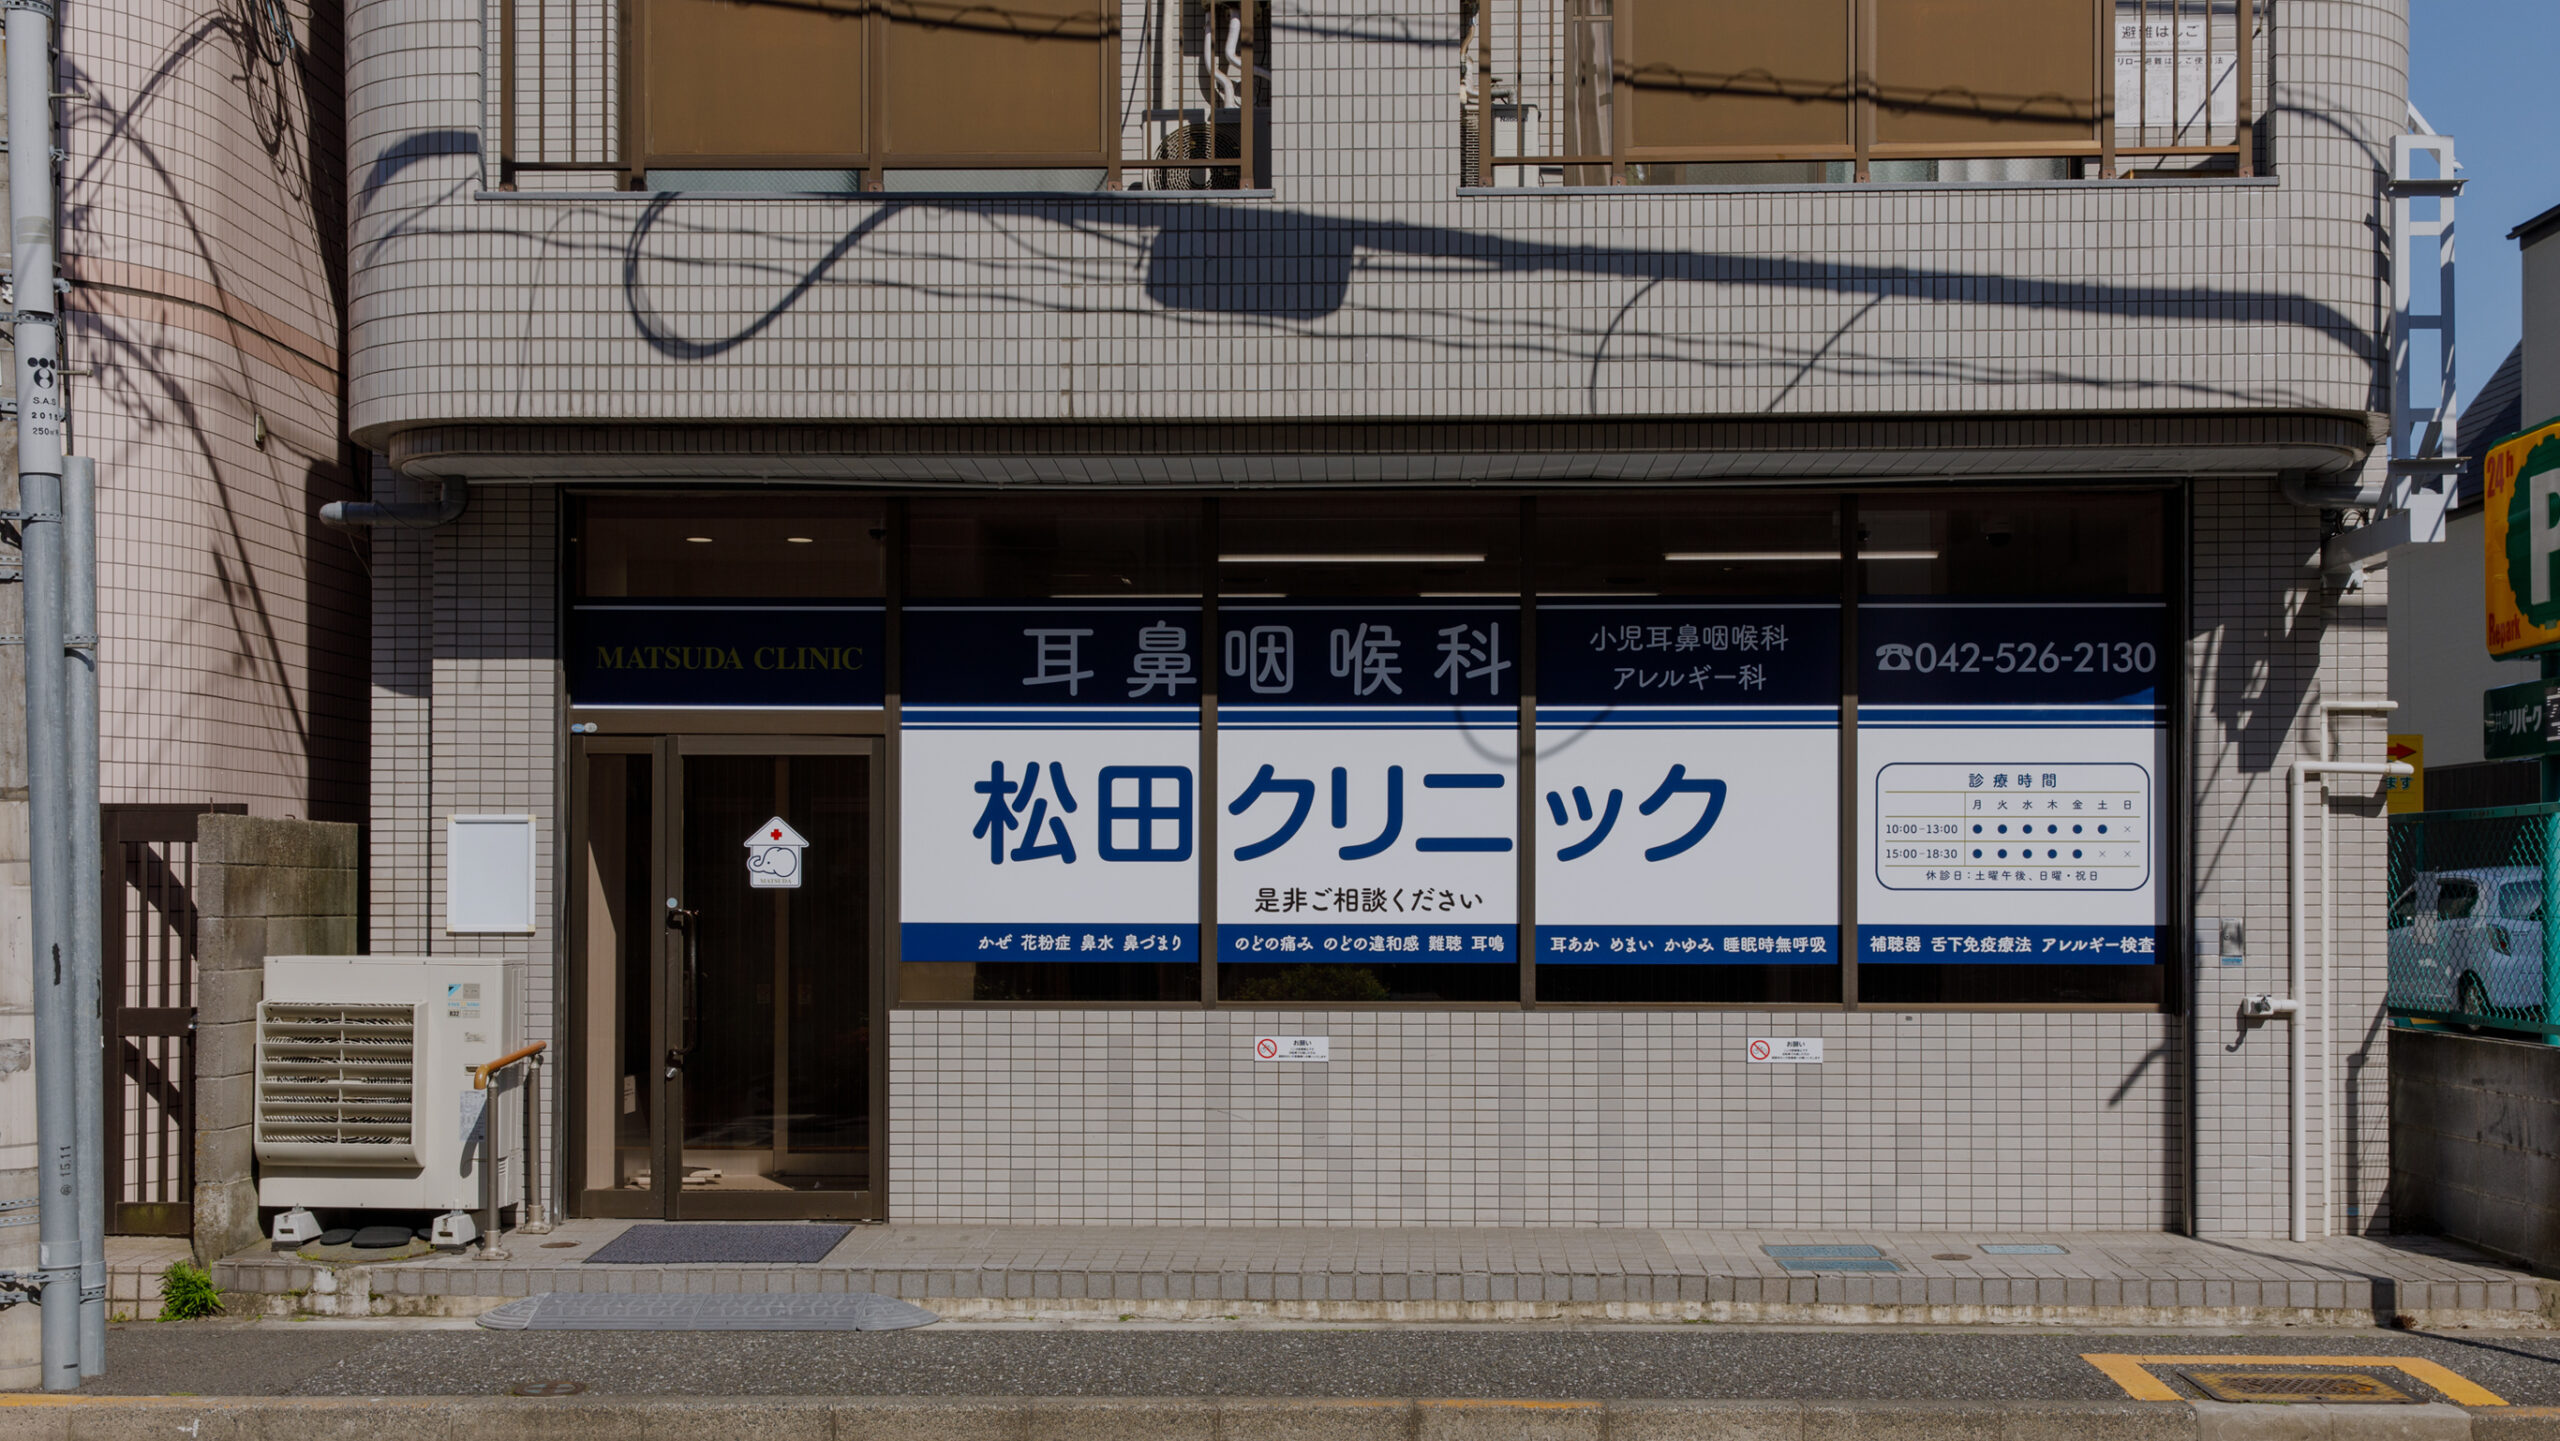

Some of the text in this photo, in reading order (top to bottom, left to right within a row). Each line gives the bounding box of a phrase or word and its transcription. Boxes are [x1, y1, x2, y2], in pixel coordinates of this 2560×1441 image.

[2530, 467, 2560, 606] P
[1590, 624, 1788, 652] 小児耳鼻咽喉科
[2488, 613, 2522, 648] Repark
[597, 647, 863, 670] MATSUDA CLINIC
[1022, 620, 1511, 697] 耳鼻咽喉科
[1914, 642, 2157, 673] 042-526-2130
[1613, 664, 1767, 691] アレルギー科
[1968, 773, 2057, 788] 診療時間
[973, 760, 1727, 865] 松田クリニック
[1972, 799, 2132, 810] 月 火 水 木 金 土 日
[1255, 887, 1483, 912] 是非ご相談ください
[979, 934, 1181, 952] かぜ 花粉症 鼻水 鼻づまり
[1235, 935, 1505, 952] のどの痛み のどの違和感 難聴 耳鳴
[1550, 936, 1827, 953] 耳あか めまい かゆみ 睡眠時無呼吸
[1870, 936, 2155, 953] 補聴器 舌下免疫療法 アレルギー検査
